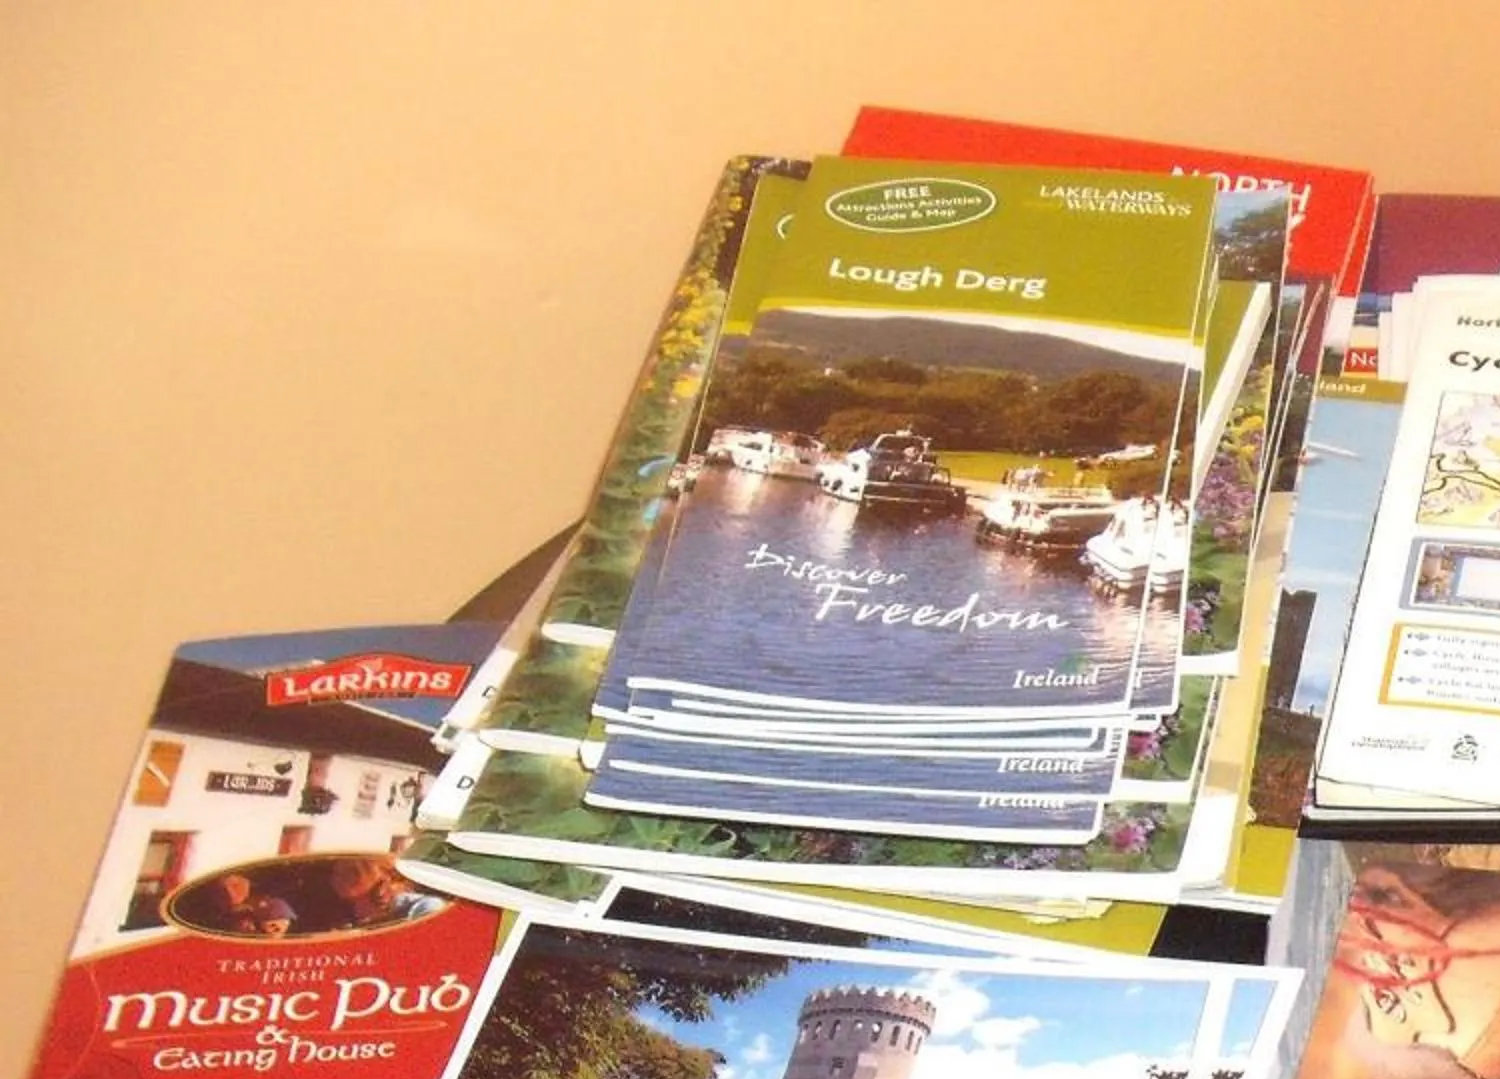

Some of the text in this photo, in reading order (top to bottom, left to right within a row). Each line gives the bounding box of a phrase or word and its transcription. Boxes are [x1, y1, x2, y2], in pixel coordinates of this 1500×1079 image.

[883, 185, 931, 200] FREE
[1040, 184, 1166, 203] LAKELANDS
[1067, 199, 1192, 217] WATERWAYS
[829, 257, 1047, 299] Lough Derg
[744, 543, 908, 586] Discover
[816, 582, 1070, 633] Freedom
[1012, 666, 1100, 689] Ireland
[997, 755, 1085, 773] Ireland
[216, 953, 380, 973] TRADITIONAL
[261, 970, 326, 985] IRISH
[256, 1025, 289, 1046] &
